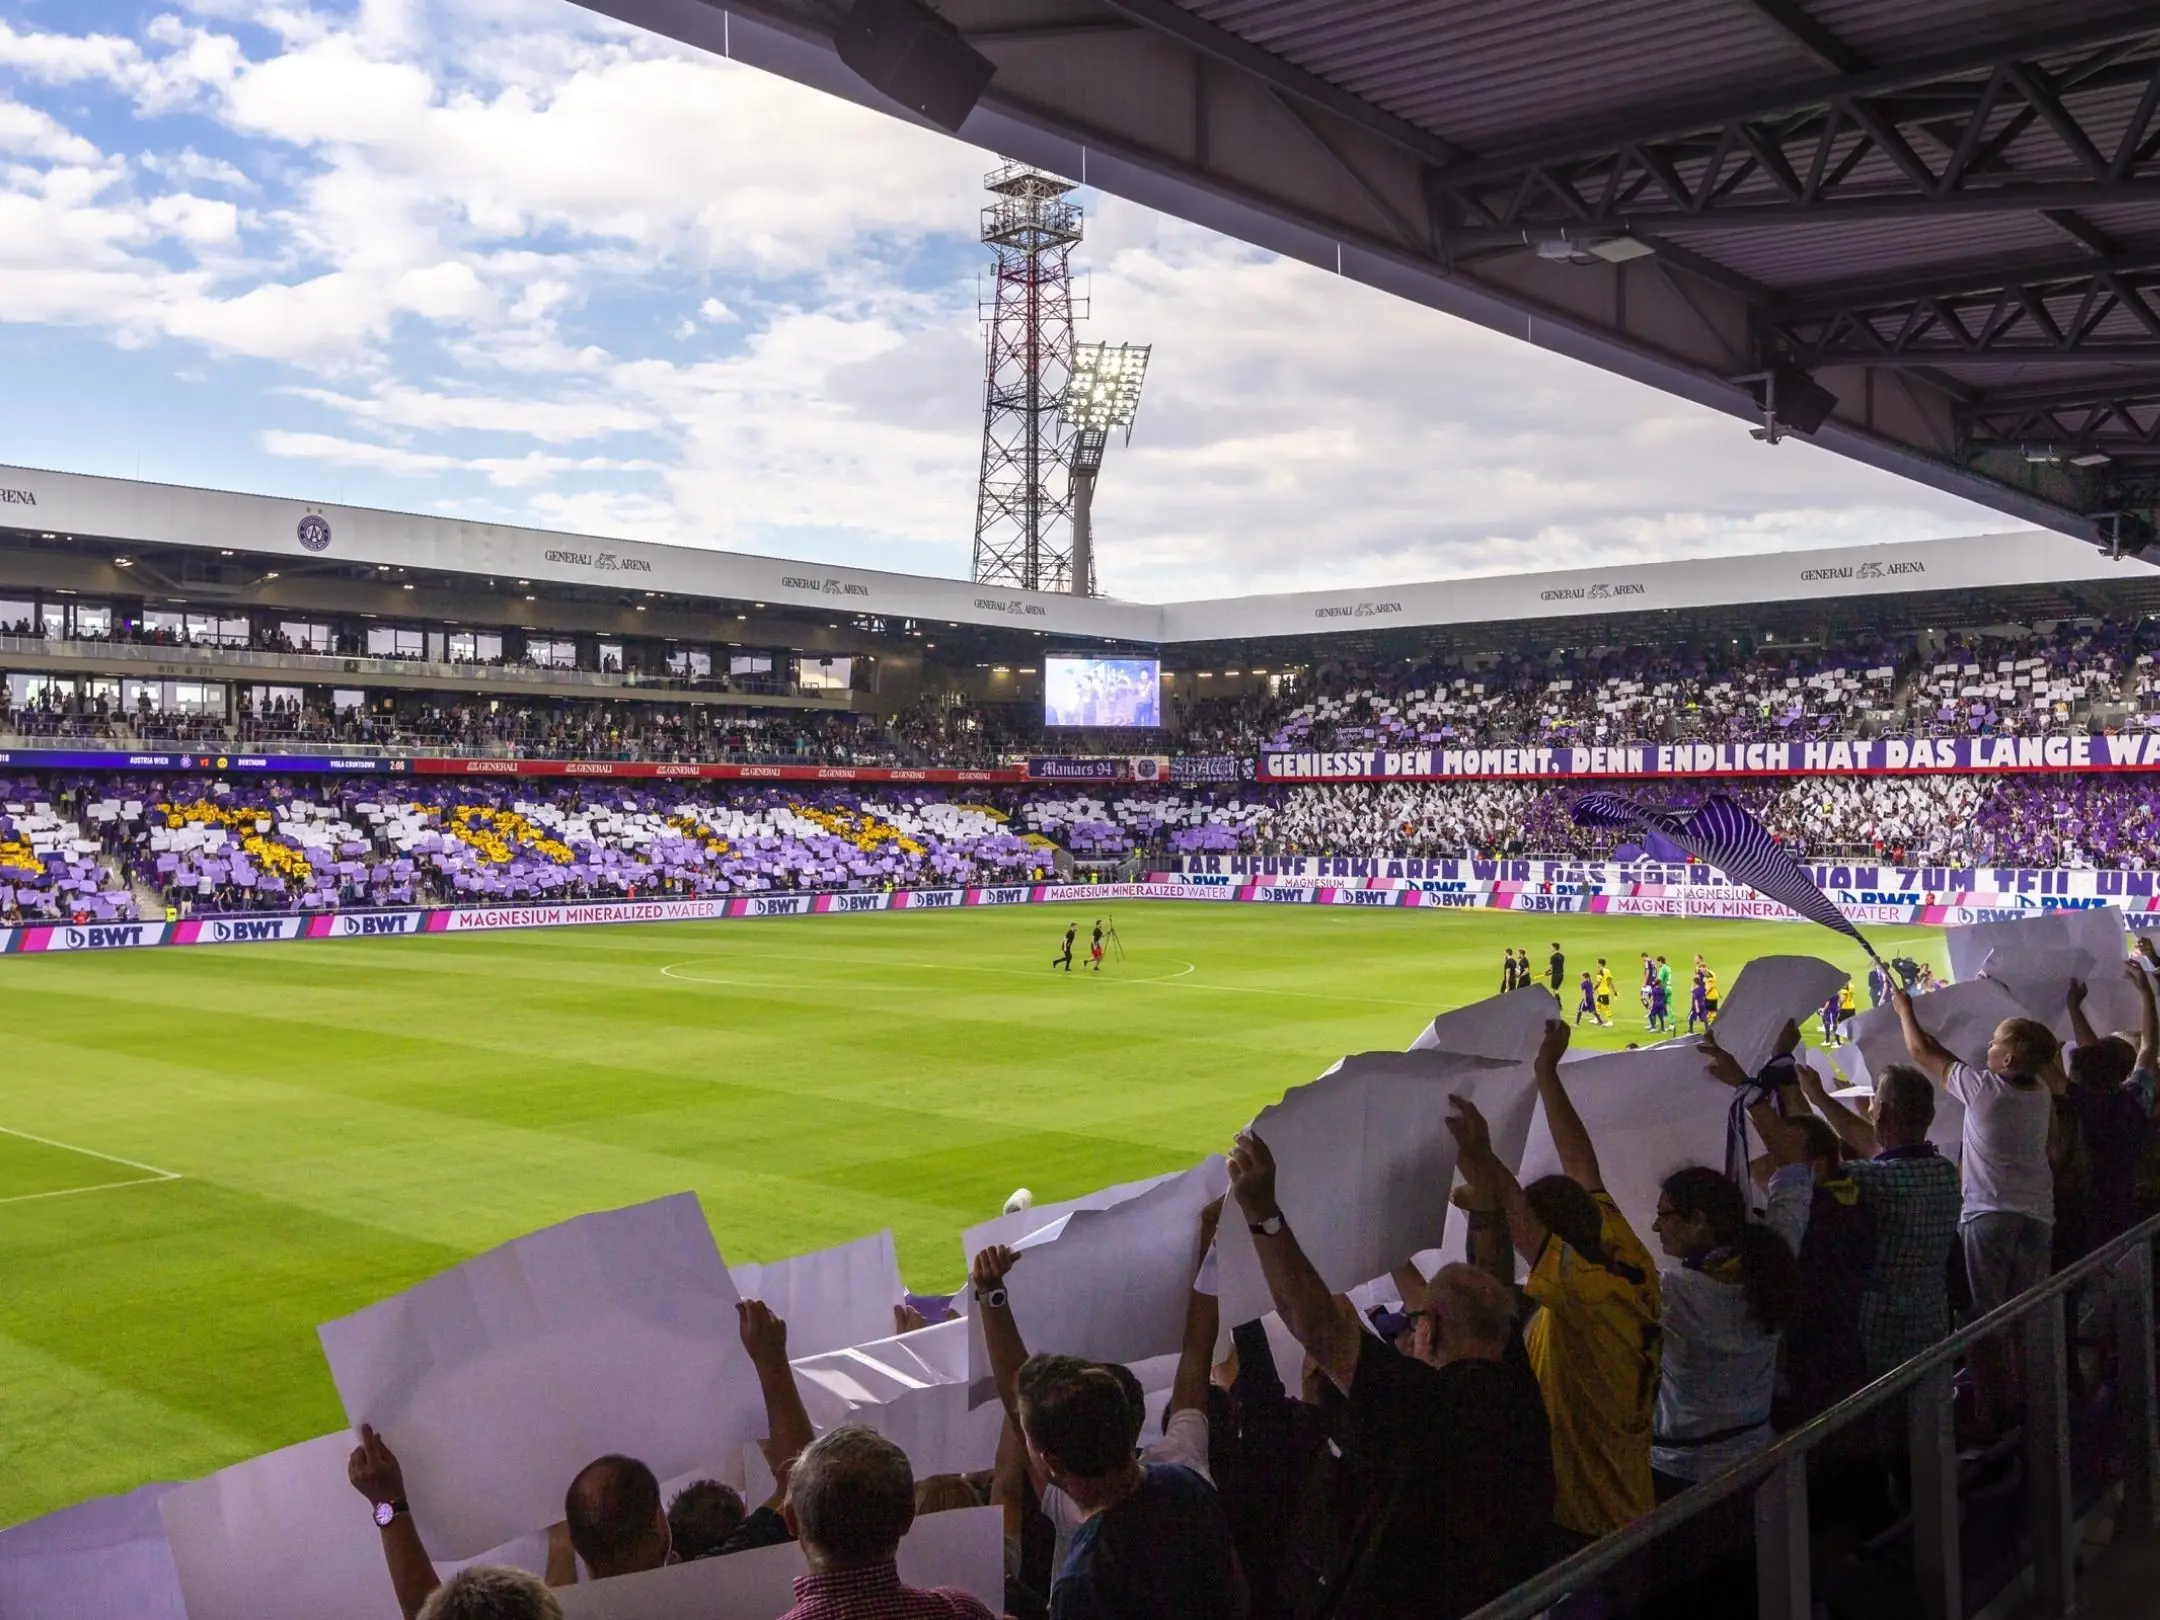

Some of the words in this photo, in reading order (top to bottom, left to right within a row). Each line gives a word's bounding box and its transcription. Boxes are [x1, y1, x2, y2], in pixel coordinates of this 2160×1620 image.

[545, 550, 592, 566] GENERALI
[620, 559, 652, 572] ARENA
[1801, 567, 1853, 581] GENERALI
[1886, 561, 1925, 575] ARENA
[781, 576, 820, 591] GENERALI
[843, 583, 868, 596] ARENA
[1540, 588, 1585, 601] GENERALI
[1613, 584, 1646, 596] ARENA
[974, 599, 1006, 612] GENERALI
[1025, 604, 1046, 616] ARENA
[1315, 606, 1353, 618] GENERALI
[1375, 602, 1402, 614] ARENA
[1267, 752, 1374, 778] GENIESST
[1384, 750, 1432, 776] DEN
[1442, 748, 1561, 776] MOMENT,
[1571, 746, 1643, 774] DENN
[1659, 742, 1789, 772] ENDLICH
[1804, 740, 1873, 770] HAT
[1886, 738, 1957, 768] DAS
[1970, 735, 2091, 768] LANGE
[480, 762, 518, 772] GENERALI
[577, 763, 613, 773] GENERALI
[667, 765, 700, 775] GENERALI
[750, 767, 781, 777] GENERALI
[826, 769, 856, 779] GENERALI
[897, 770, 926, 780] GENERALI
[1040, 761, 1094, 776] Maniacs
[1096, 763, 1113, 776] 94
[1471, 859, 1531, 881] WIR
[1050, 885, 1109, 900] MAGNESIUM
[1112, 883, 1184, 898] MINERALIZED
[1187, 885, 1227, 898] WATER
[1285, 878, 1345, 889] MAGNESIUM
[849, 895, 880, 910] BWT
[925, 892, 954, 907] BWT
[996, 888, 1022, 902] BWT
[1273, 888, 1304, 902] BWT
[1355, 890, 1387, 904] BWT
[1442, 893, 1477, 907] BWT
[1535, 895, 1572, 911] BWT
[767, 898, 799, 915] BWT
[1617, 899, 1716, 914] MAGNESIUM
[1838, 905, 1900, 921] WATER
[459, 908, 560, 928] MAGNESIUM
[566, 904, 663, 924] MINERALIZED
[667, 902, 715, 919] WATER
[2122, 913, 2160, 930] WT
[234, 919, 283, 940] BWT
[362, 915, 407, 934] BWT
[88, 926, 143, 947] BWT
